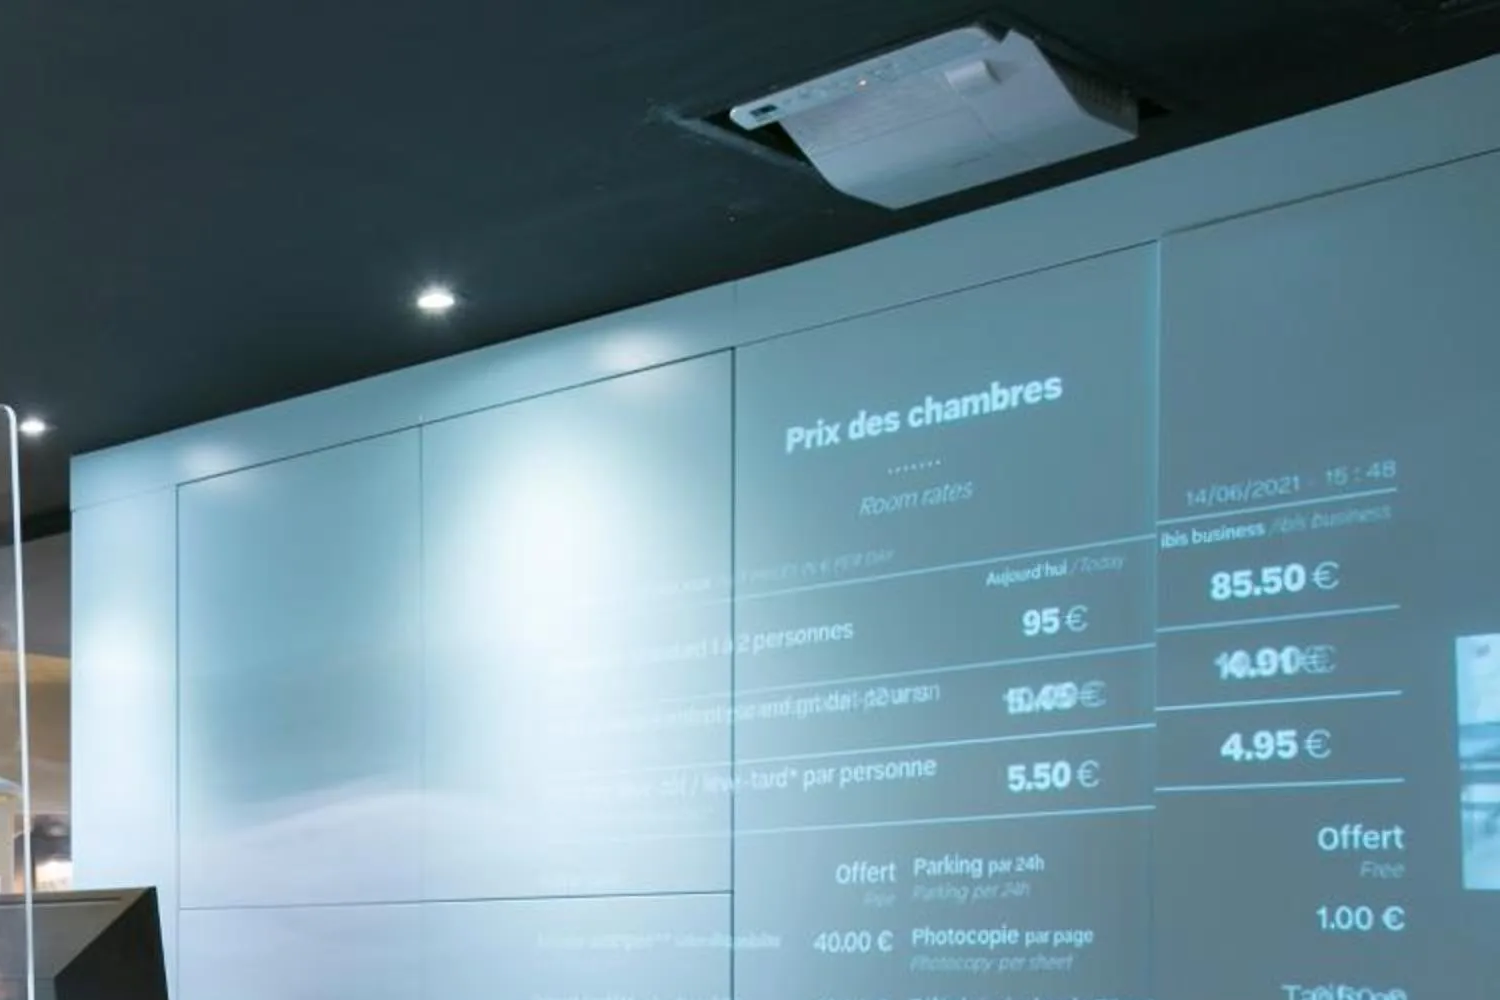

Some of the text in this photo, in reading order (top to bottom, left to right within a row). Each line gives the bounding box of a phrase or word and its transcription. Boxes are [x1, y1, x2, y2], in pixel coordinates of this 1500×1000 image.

[784, 376, 1063, 453] Prix des chambres
[859, 480, 975, 517] Room rates
[1185, 476, 1300, 507] 14/06/2021
[1160, 531, 1189, 549] ibis
[1192, 520, 1267, 545] business
[985, 557, 1068, 588] Aujourd'hui
[1210, 560, 1341, 602] 85.50 €
[1021, 604, 1089, 637] 95 €
[752, 621, 855, 657] personnes
[1220, 728, 1333, 762] 4.95 €
[802, 766, 839, 792] par
[839, 757, 939, 788] personne
[1006, 759, 1101, 793] 5.50 €
[1316, 823, 1406, 851] Offert
[834, 861, 898, 886] Offert
[912, 851, 1046, 879] Parking par 24h
[1358, 860, 1406, 880] Free
[1315, 904, 1406, 932] 1.00 €
[812, 929, 895, 954] 40.00 €
[911, 924, 1094, 951] Photocopie par page
